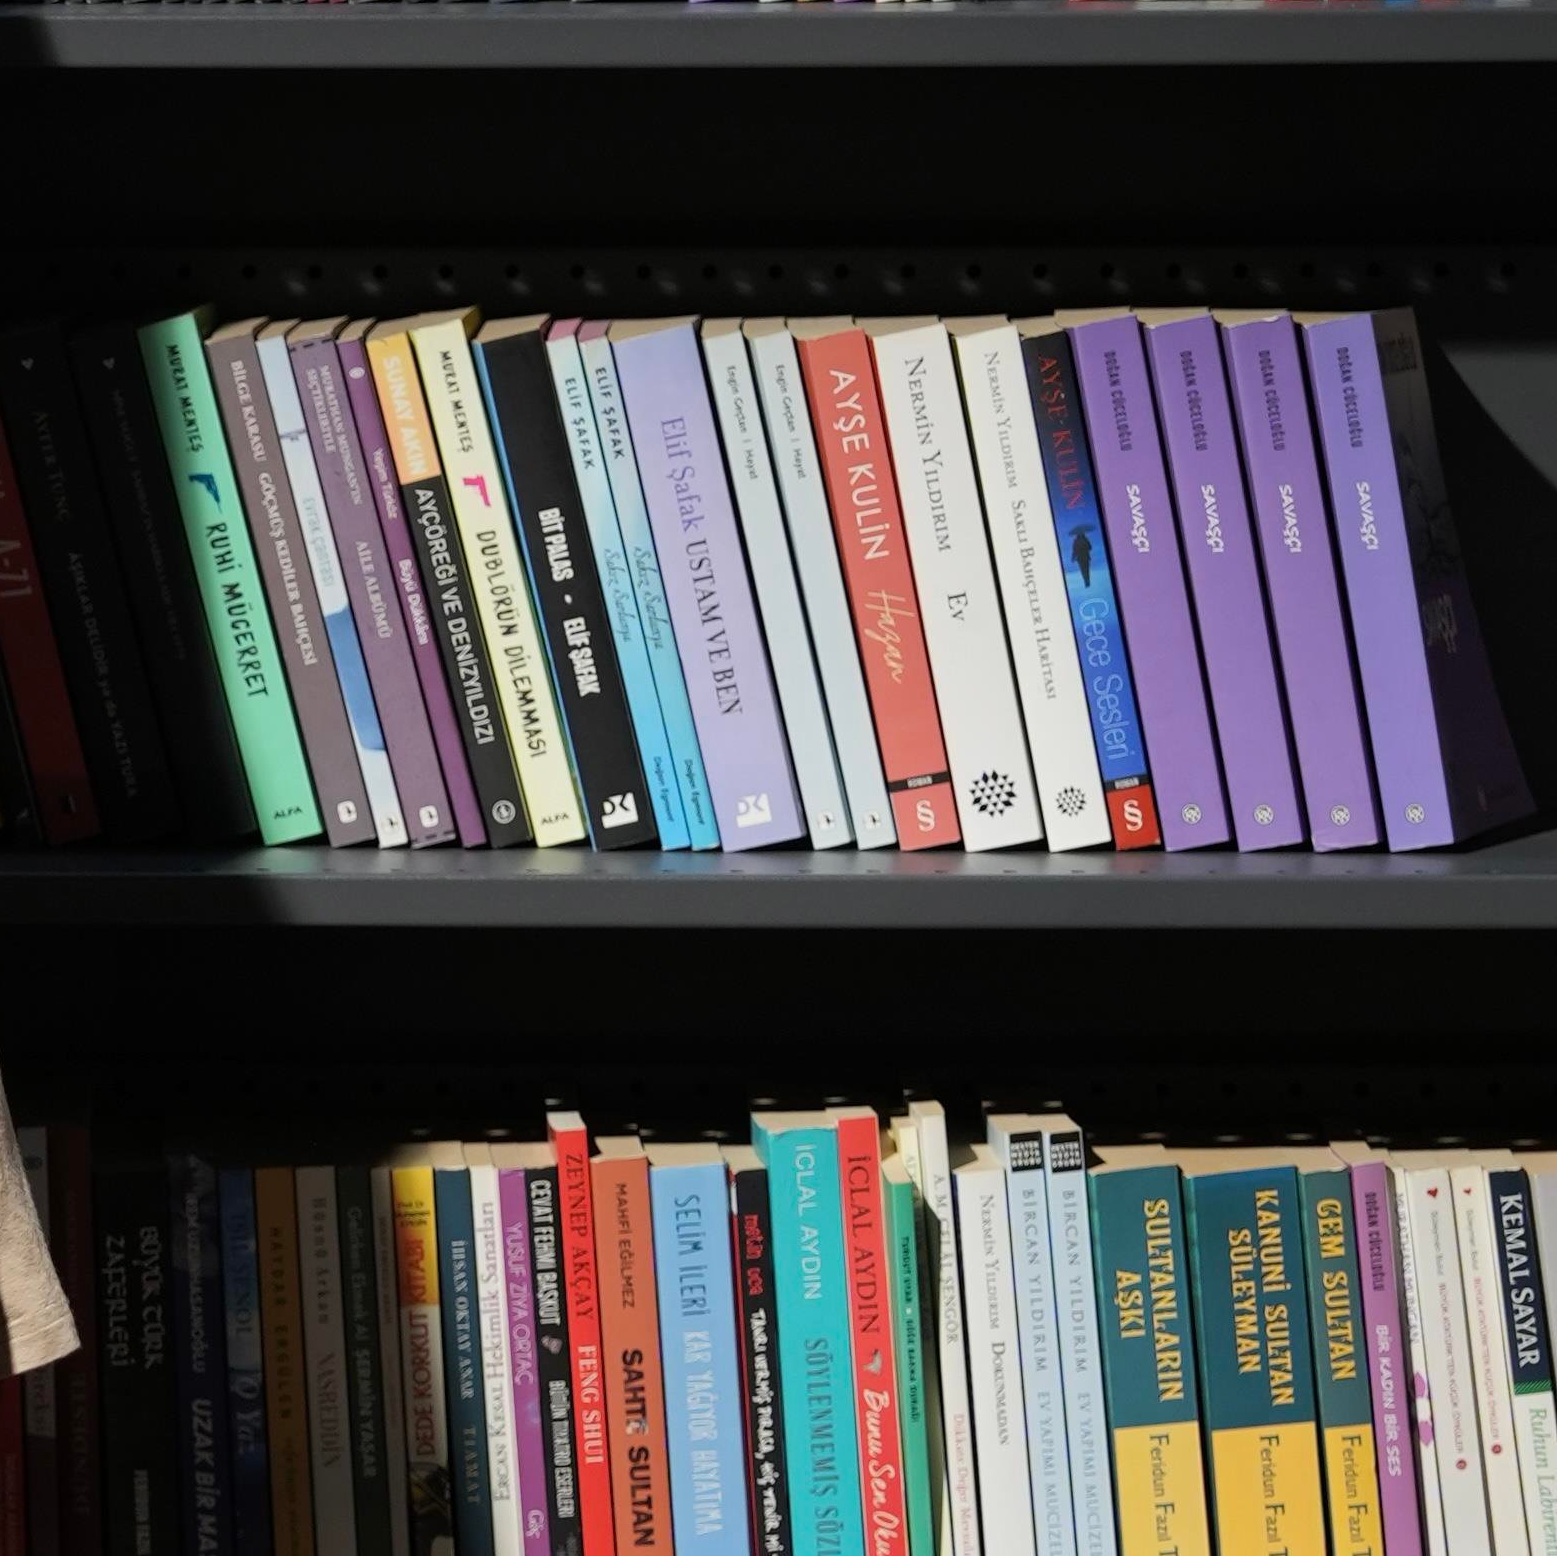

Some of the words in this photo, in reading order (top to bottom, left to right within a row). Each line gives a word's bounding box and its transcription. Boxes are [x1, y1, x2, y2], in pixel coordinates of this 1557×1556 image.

[660, 415, 691, 460] Elif
[829, 367, 870, 453] AYŞE
[665, 463, 698, 530] Şafak
[847, 462, 889, 562] KULİN
[1126, 484, 1150, 554] SAVAŞÇI
[206, 521, 242, 572] RUHİ
[685, 537, 720, 625] USTAM
[222, 583, 269, 698] MÜCERRET
[703, 631, 731, 665] VE
[1078, 597, 1113, 668] Gece
[715, 667, 744, 715] BEN
[1093, 673, 1135, 761] Sesleri
[565, 1152, 587, 1240] ZEYNEP
[794, 1143, 816, 1215] İCLAL
[674, 1195, 699, 1256] SELİM
[798, 1223, 824, 1301] AYDIN
[1254, 1188, 1291, 1301] KANUNİ
[571, 1242, 595, 1320] AKÇAY
[1115, 1270, 1145, 1339] AŞKI
[1142, 1198, 1185, 1403] SULTANLARIN
[1228, 1228, 1262, 1376] SÜLEYMAN
[578, 1346, 598, 1404] FENG
[621, 1349, 648, 1436] SAHTE
[1264, 1303, 1295, 1407] SULTAN
[582, 1407, 605, 1465] SHUI
[804, 1337, 839, 1496] SÖYLENMEMİŞ
[627, 1446, 655, 1548] SULTAN
